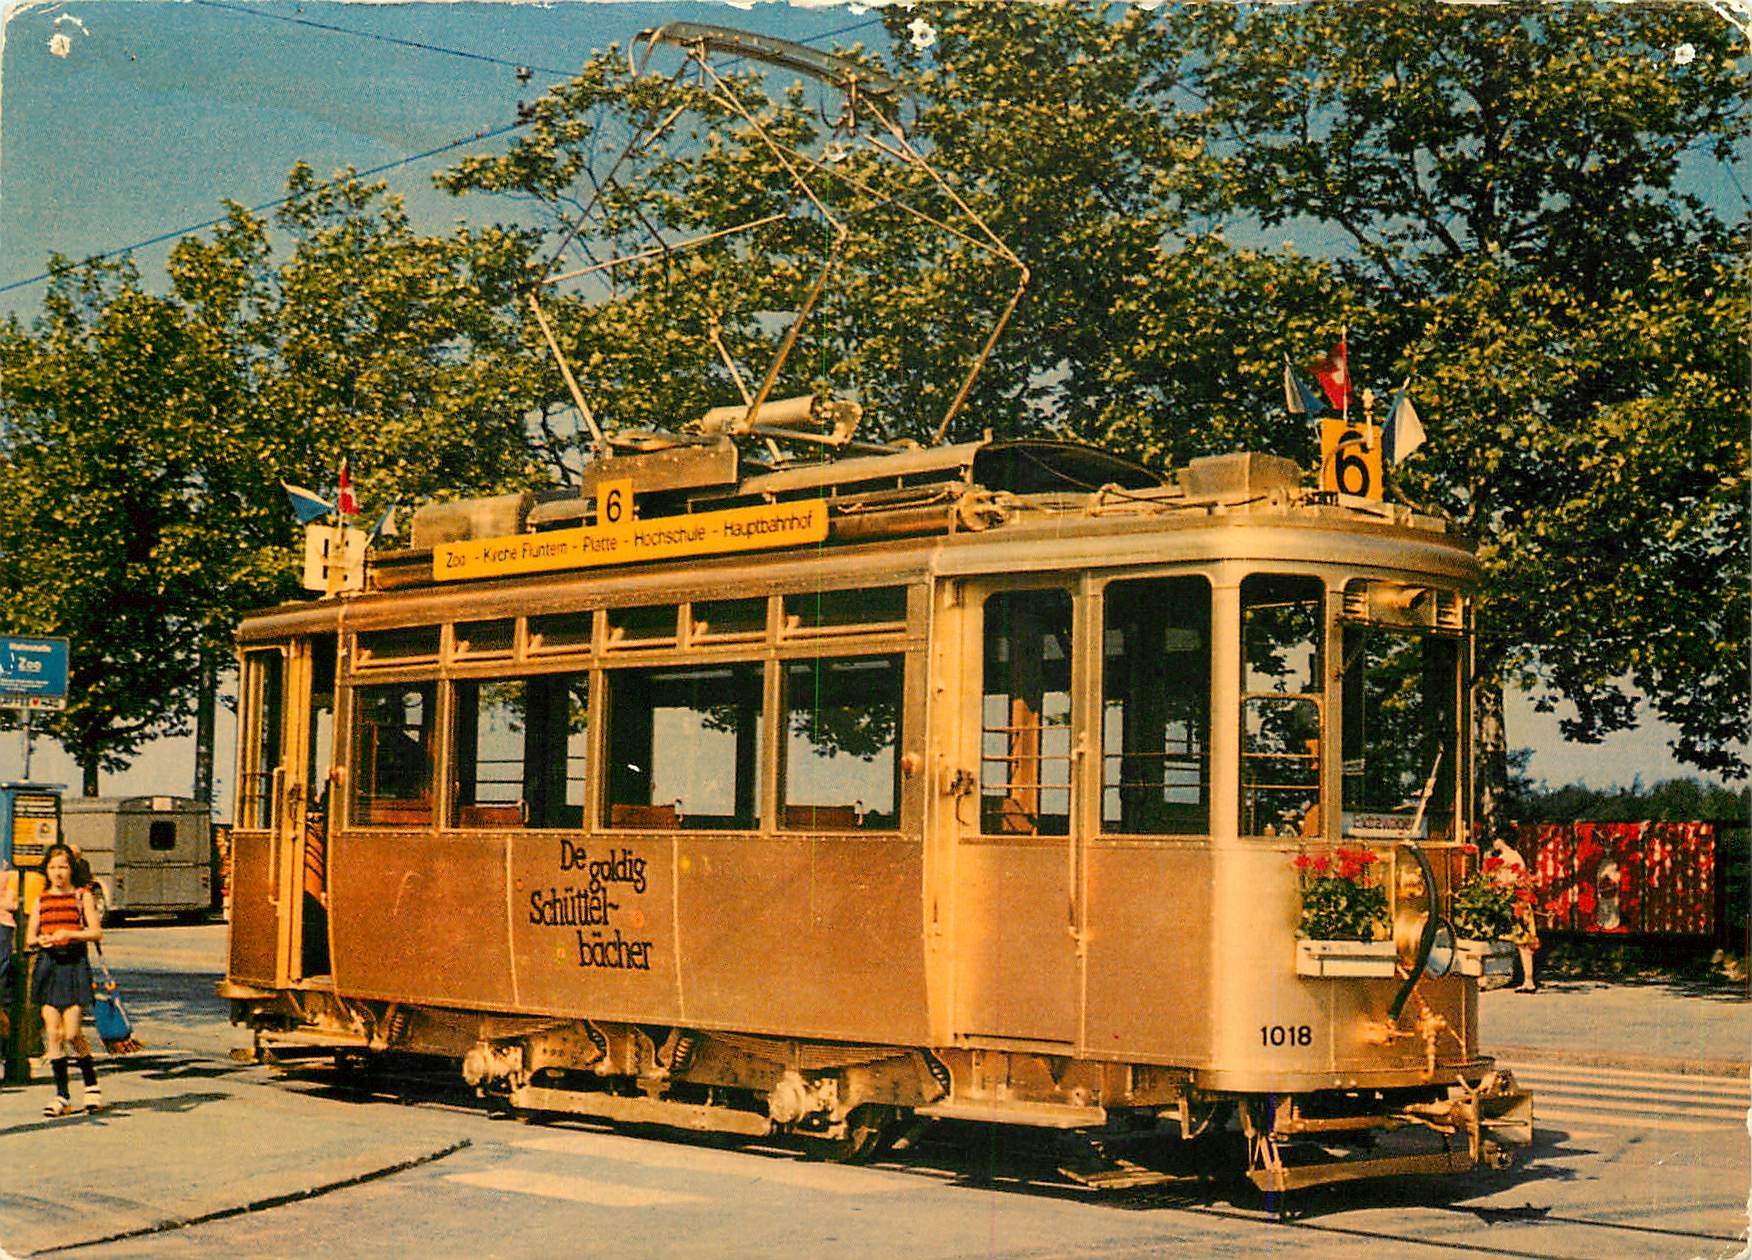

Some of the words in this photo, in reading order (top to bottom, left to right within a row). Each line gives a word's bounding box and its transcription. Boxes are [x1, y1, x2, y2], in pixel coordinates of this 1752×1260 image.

[1336, 430, 1370, 497] 6
[606, 489, 621, 522] 6
[446, 551, 465, 568] Zoo
[483, 547, 518, 563] Kirche
[522, 540, 568, 560] Fluntern
[583, 535, 617, 552] Platte
[634, 526, 706, 547] Hochschule
[724, 510, 813, 539] Hauptbahnhof
[560, 839, 586, 870] De
[589, 848, 646, 894] goldig
[529, 886, 619, 926] Schüttel-
[576, 929, 652, 970] bächer
[1261, 1025, 1312, 1047] 1018
